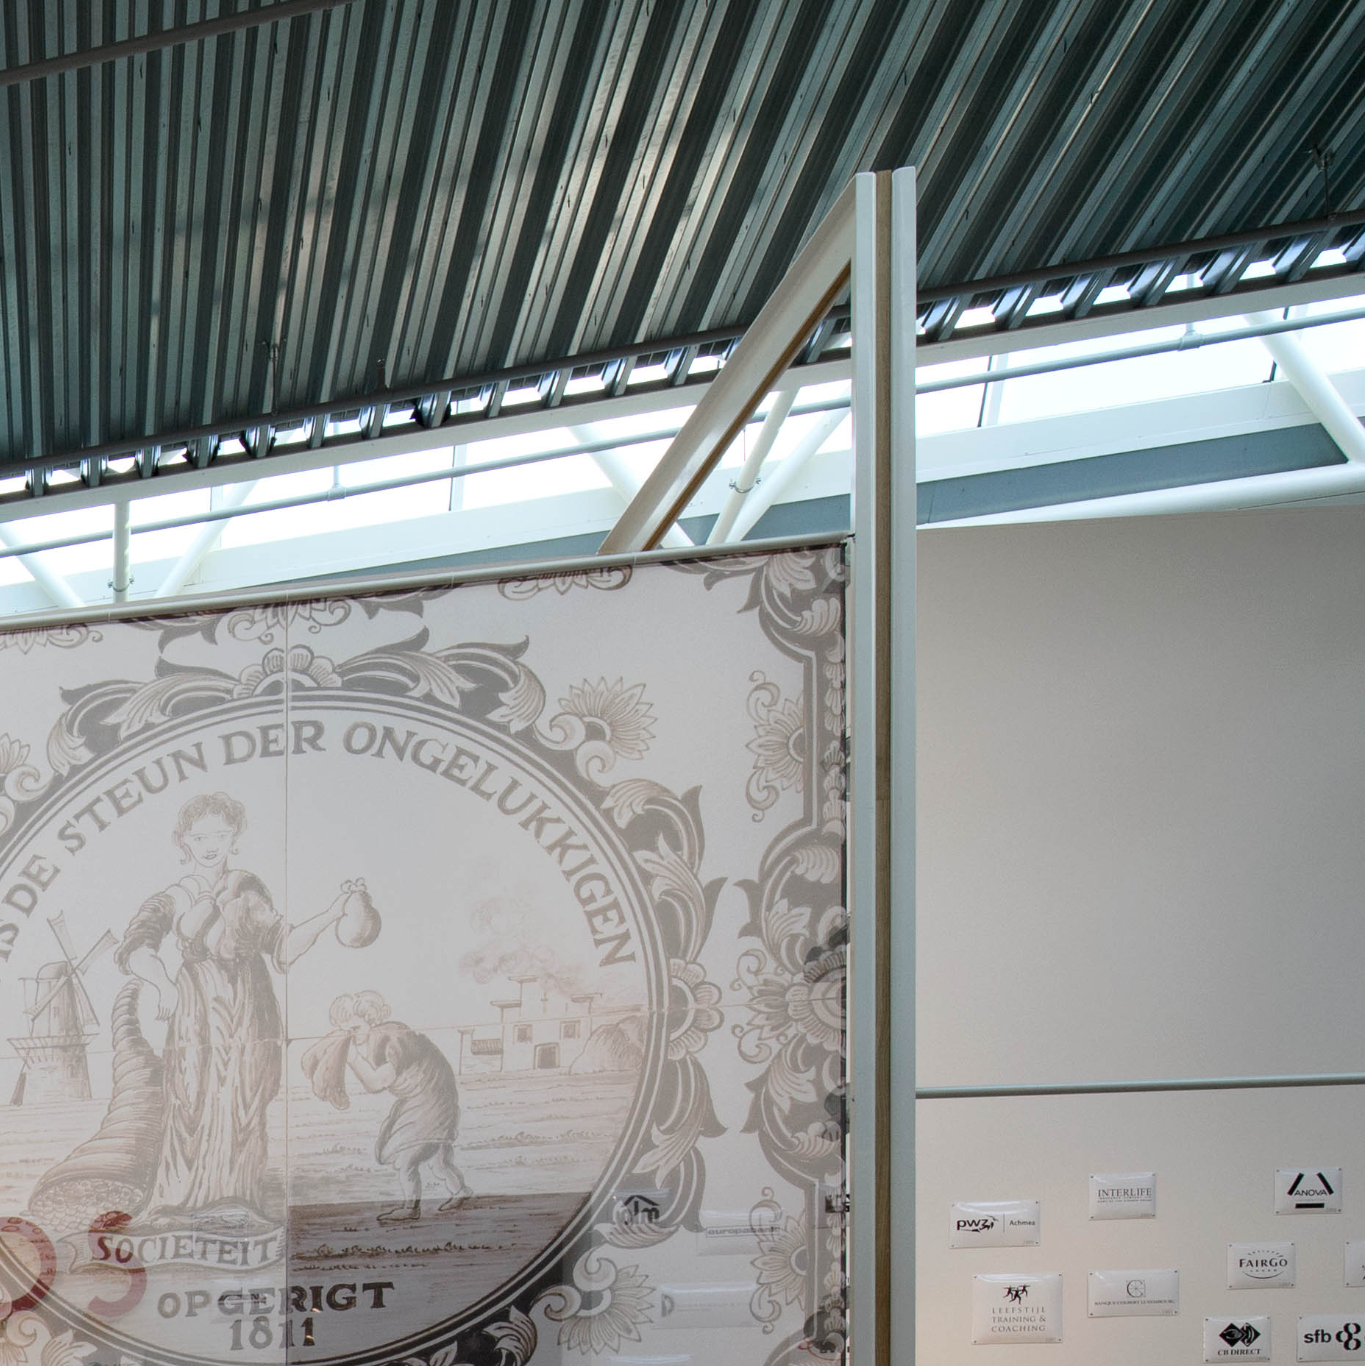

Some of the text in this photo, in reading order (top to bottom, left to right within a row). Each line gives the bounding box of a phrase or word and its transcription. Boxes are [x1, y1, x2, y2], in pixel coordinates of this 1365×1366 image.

[4, 853, 62, 922] DE
[56, 741, 209, 856] STEUN
[218, 720, 325, 766] DER
[342, 721, 637, 968] ONGELUKKIGEN
[1098, 1188, 1152, 1198] INTERLIFE
[1294, 1189, 1328, 1197] ANOVA
[98, 1234, 280, 1266] SOCIETEIT
[156, 1281, 395, 1319] OPGERIGT
[229, 1316, 316, 1351] 1811
[1303, 1329, 1332, 1344] sfb
[1231, 1348, 1261, 1356] DIRECT
